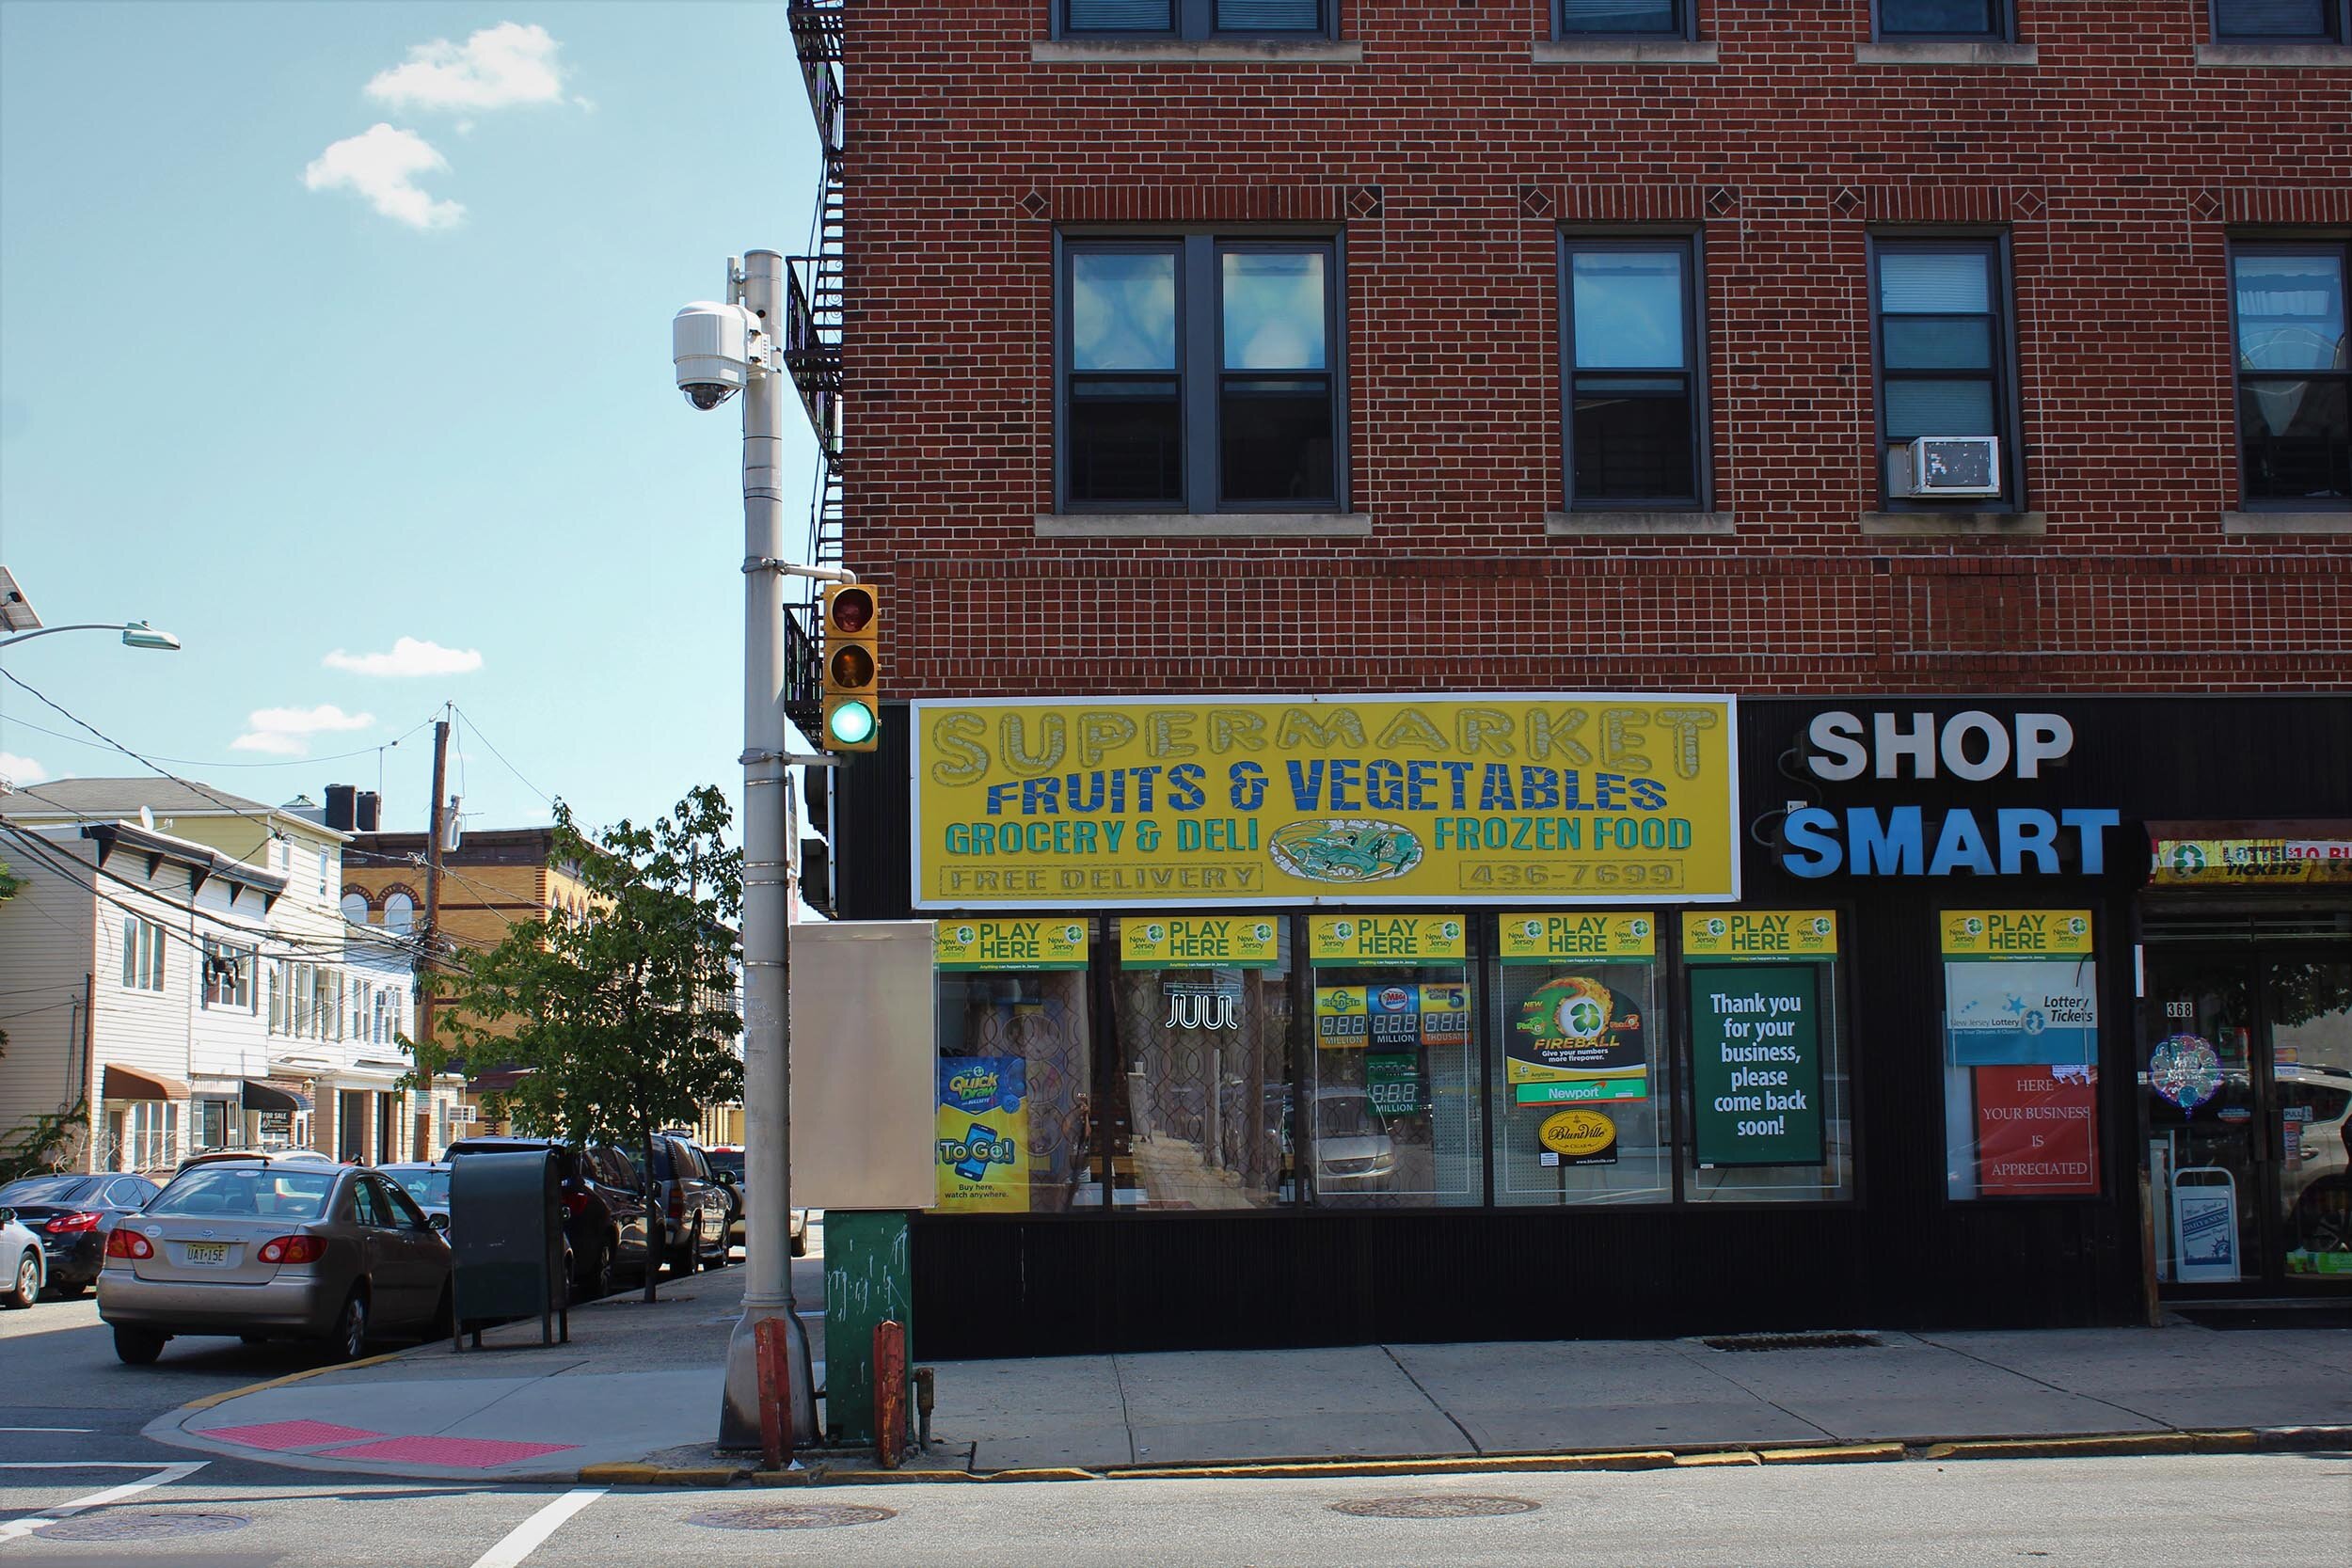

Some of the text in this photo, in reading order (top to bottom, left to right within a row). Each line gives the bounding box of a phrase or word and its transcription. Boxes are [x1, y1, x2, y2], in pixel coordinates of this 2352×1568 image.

[932, 707, 1718, 787] SUPERMARKET
[1807, 710, 2074, 782] SHOP
[986, 758, 1668, 816] FRUITS & VEGETABLES
[945, 817, 1259, 856] GROCERY & DELI
[1435, 816, 1692, 851] FROZEN FOOD
[1782, 805, 2121, 879] SMART
[1470, 863, 1673, 886] 436-7699
[2226, 863, 2302, 876] TICKETS
[950, 866, 1251, 892] FREE DELIVERY
[1169, 921, 1231, 938] PLAY
[1359, 918, 1419, 936] PLAY
[1548, 917, 1608, 934] PLAY
[1730, 915, 1790, 932] PLAY
[1988, 914, 2046, 931] PLAY
[979, 923, 1041, 940] PLAY
[1051, 943, 1075, 952] Jersey
[1133, 942, 1156, 950] Jersey
[1169, 940, 1230, 957] HERE
[1359, 937, 1418, 954] HERE
[1548, 935, 1608, 952] HERE
[1731, 933, 1790, 950] HERE
[1989, 932, 2046, 949] HERE
[979, 942, 1041, 958] HERE
[1710, 992, 1802, 1018] Thank you
[2044, 995, 2090, 1009] Lottery
[2168, 1003, 2192, 1017] 368
[1165, 994, 1238, 1031] JUUL
[1724, 1018, 1795, 1042] for your
[1992, 1019, 2020, 1027] Lottery
[1325, 1037, 1363, 1045] MILLION
[1377, 1035, 1415, 1043] MILLION
[1534, 1035, 1620, 1051] FIREBALL
[1721, 1042, 1802, 1064] business,
[1731, 1066, 1788, 1092] please
[2017, 1080, 2054, 1092] HERE
[1549, 1087, 1599, 1100] Newport
[1714, 1089, 1807, 1112] come back
[1375, 1104, 1414, 1113] MILLION
[1983, 1107, 2090, 1120] YOUR BUSINESS
[1737, 1115, 1785, 1136] soon!
[2032, 1135, 2044, 1148] IS
[1992, 1163, 2088, 1176] APPRECIATED
